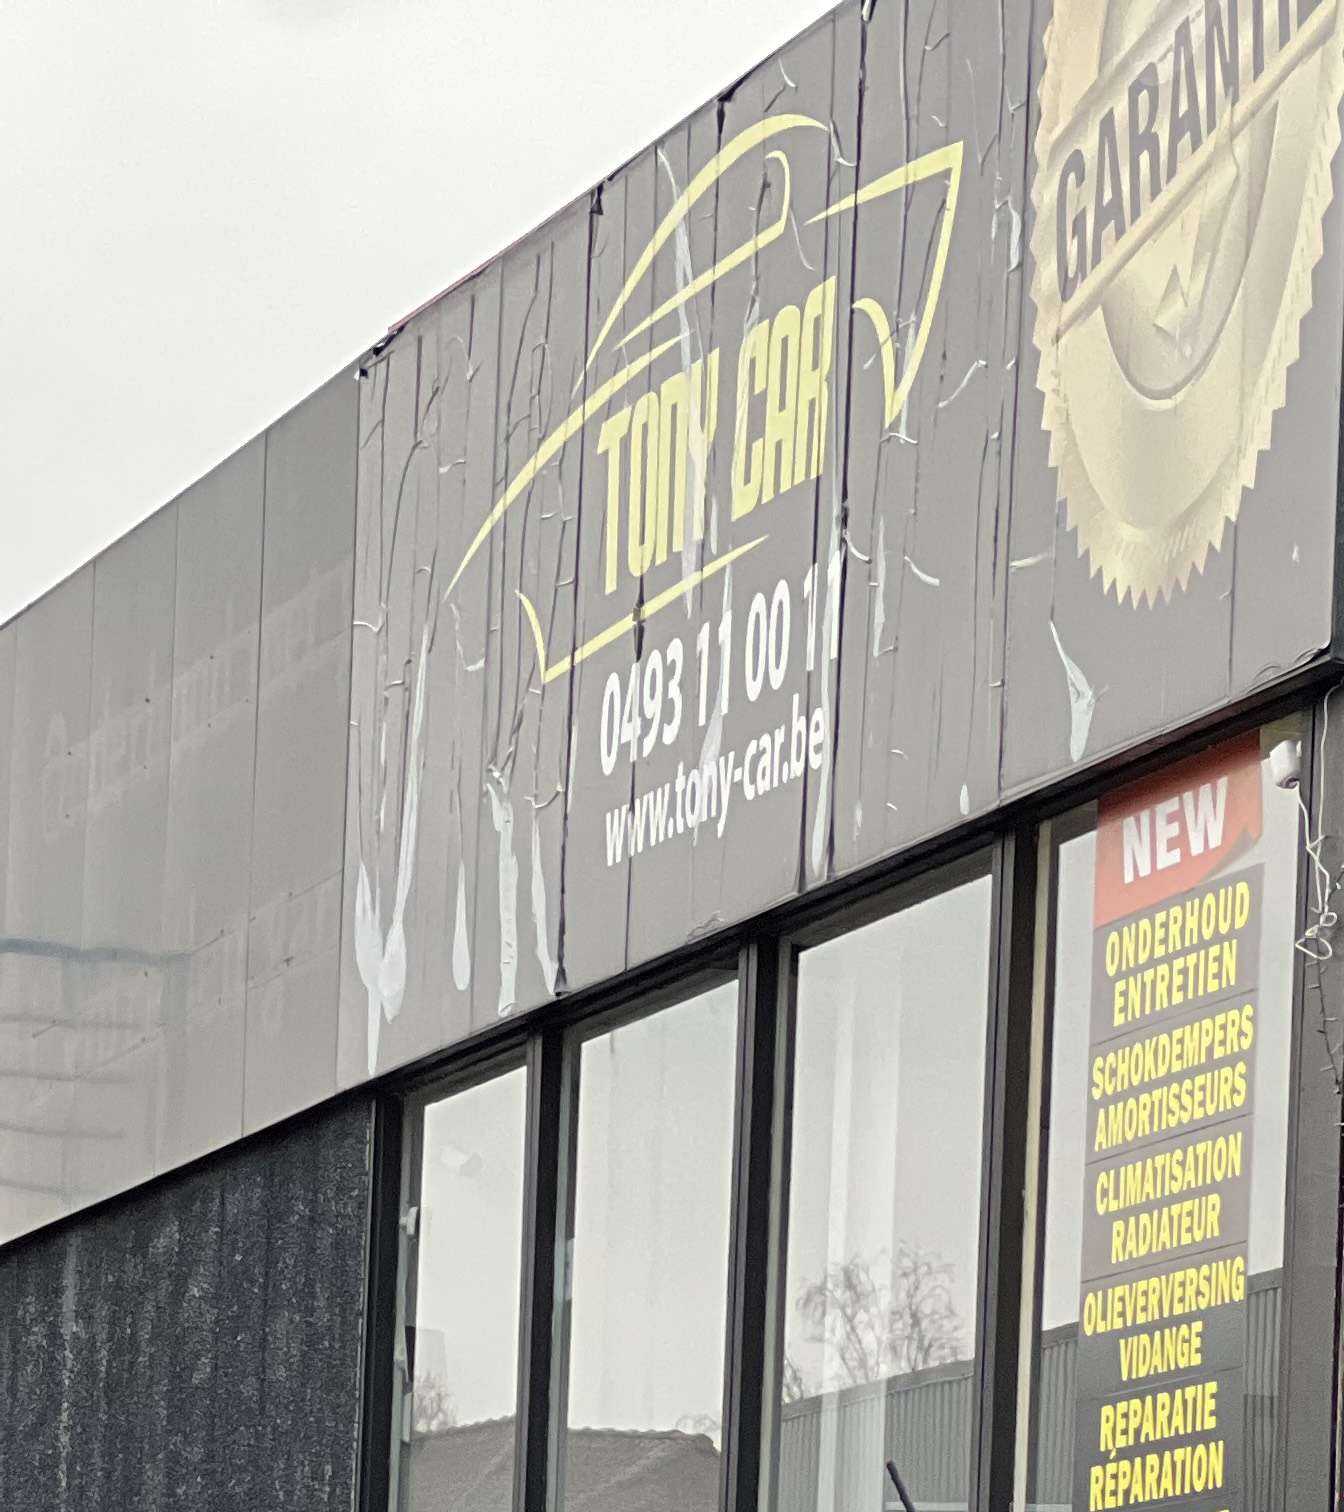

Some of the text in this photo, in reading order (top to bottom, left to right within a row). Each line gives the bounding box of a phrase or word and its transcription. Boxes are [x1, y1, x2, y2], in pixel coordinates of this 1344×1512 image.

[597, 275, 836, 596] TONY CAR
[600, 637, 684, 777] 0493
[696, 609, 733, 727] 11
[745, 579, 791, 702] 00
[605, 692, 826, 867] www.tony-car.be
[1122, 778, 1229, 885] NEW
[1105, 881, 1250, 978] ONDERHOUD
[1113, 938, 1238, 1028] ENTRETIEN
[1091, 1004, 1254, 1100] SCHOKDEMPERS
[1094, 1061, 1248, 1152] AMORTISSEURS
[1095, 1131, 1243, 1217] CLIMATISATION
[1110, 1193, 1221, 1264] RADIATEUR
[1083, 1256, 1245, 1336] OLIEVERVERSING
[1119, 1320, 1203, 1381] VIDANGE
[1100, 1381, 1218, 1452] REPARATIE
[1089, 1440, 1224, 1512] RÉPARATION
